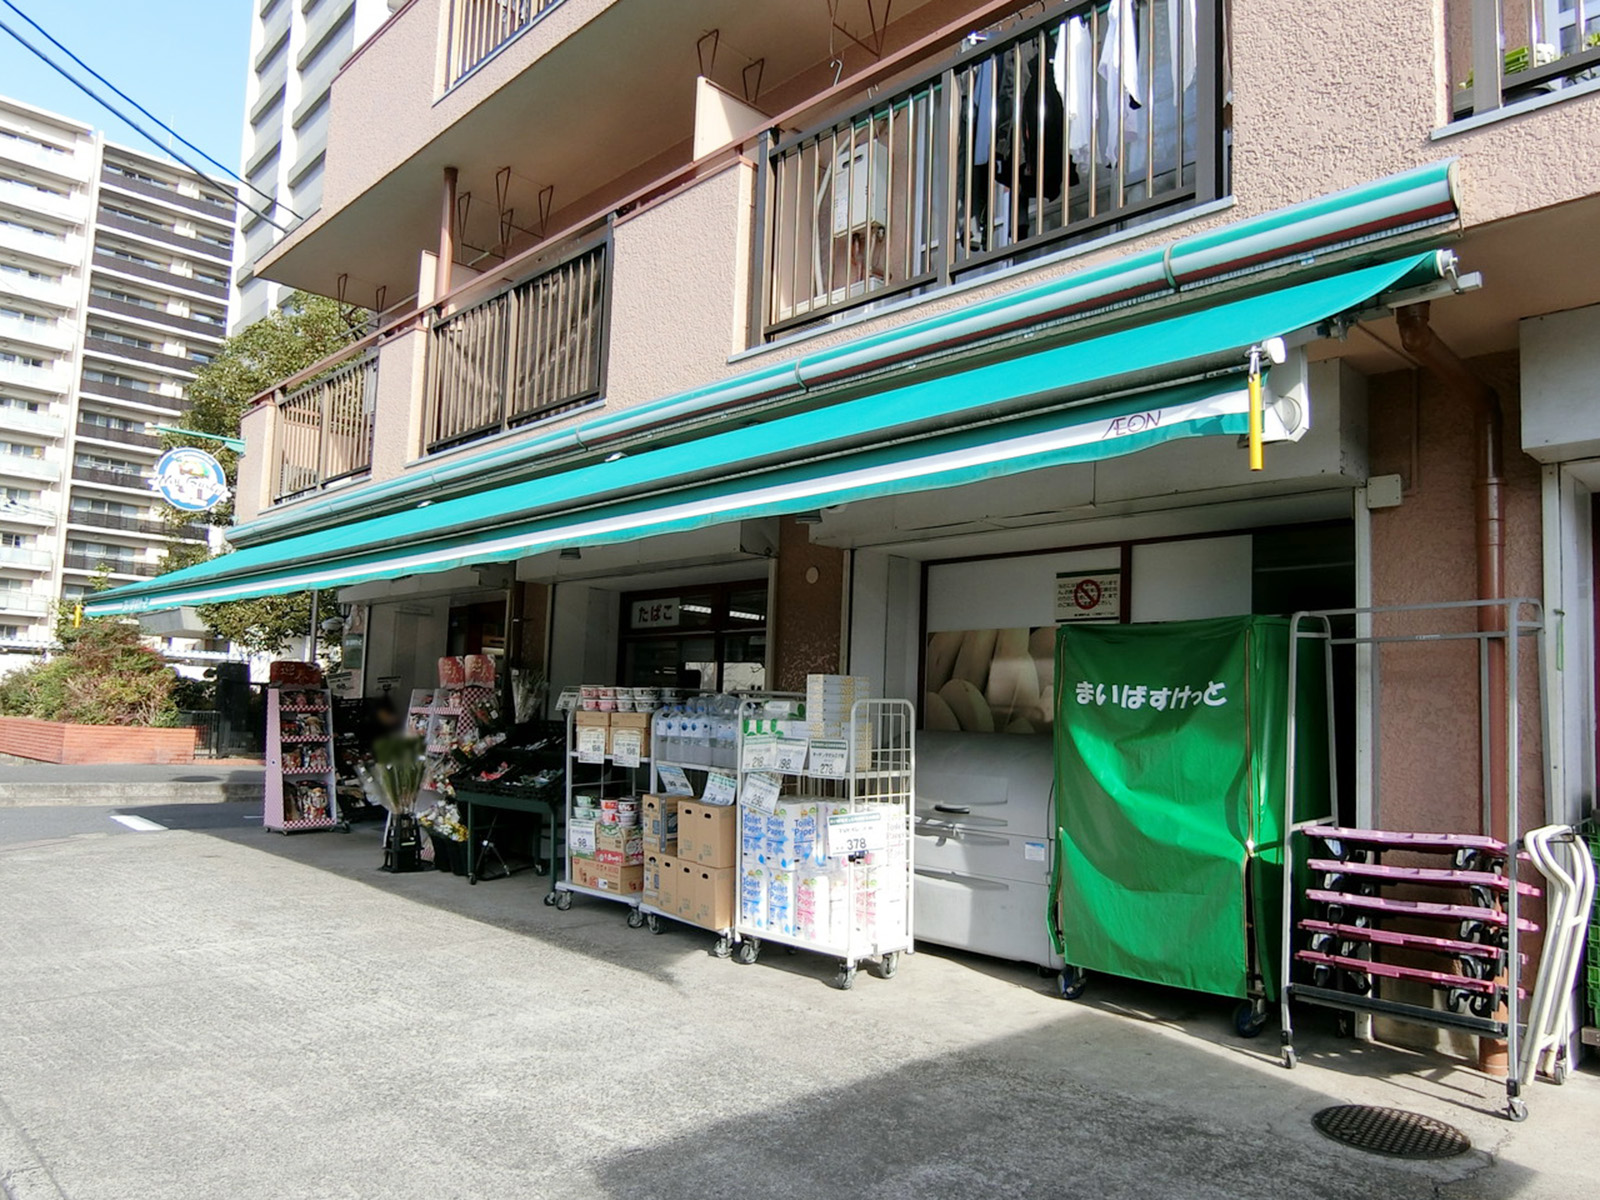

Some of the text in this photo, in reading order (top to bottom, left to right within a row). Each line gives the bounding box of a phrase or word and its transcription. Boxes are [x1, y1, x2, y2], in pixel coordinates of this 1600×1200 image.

[638, 604, 673, 623] たばこ
[1075, 680, 1228, 711] まいばすけっと
[743, 812, 762, 825] Toilet
[767, 816, 785, 828] Toilet
[794, 818, 815, 830] Toilet
[743, 822, 763, 834] Paper
[766, 825, 786, 837] Paper
[794, 827, 816, 838] Paper
[846, 838, 867, 851] 378
